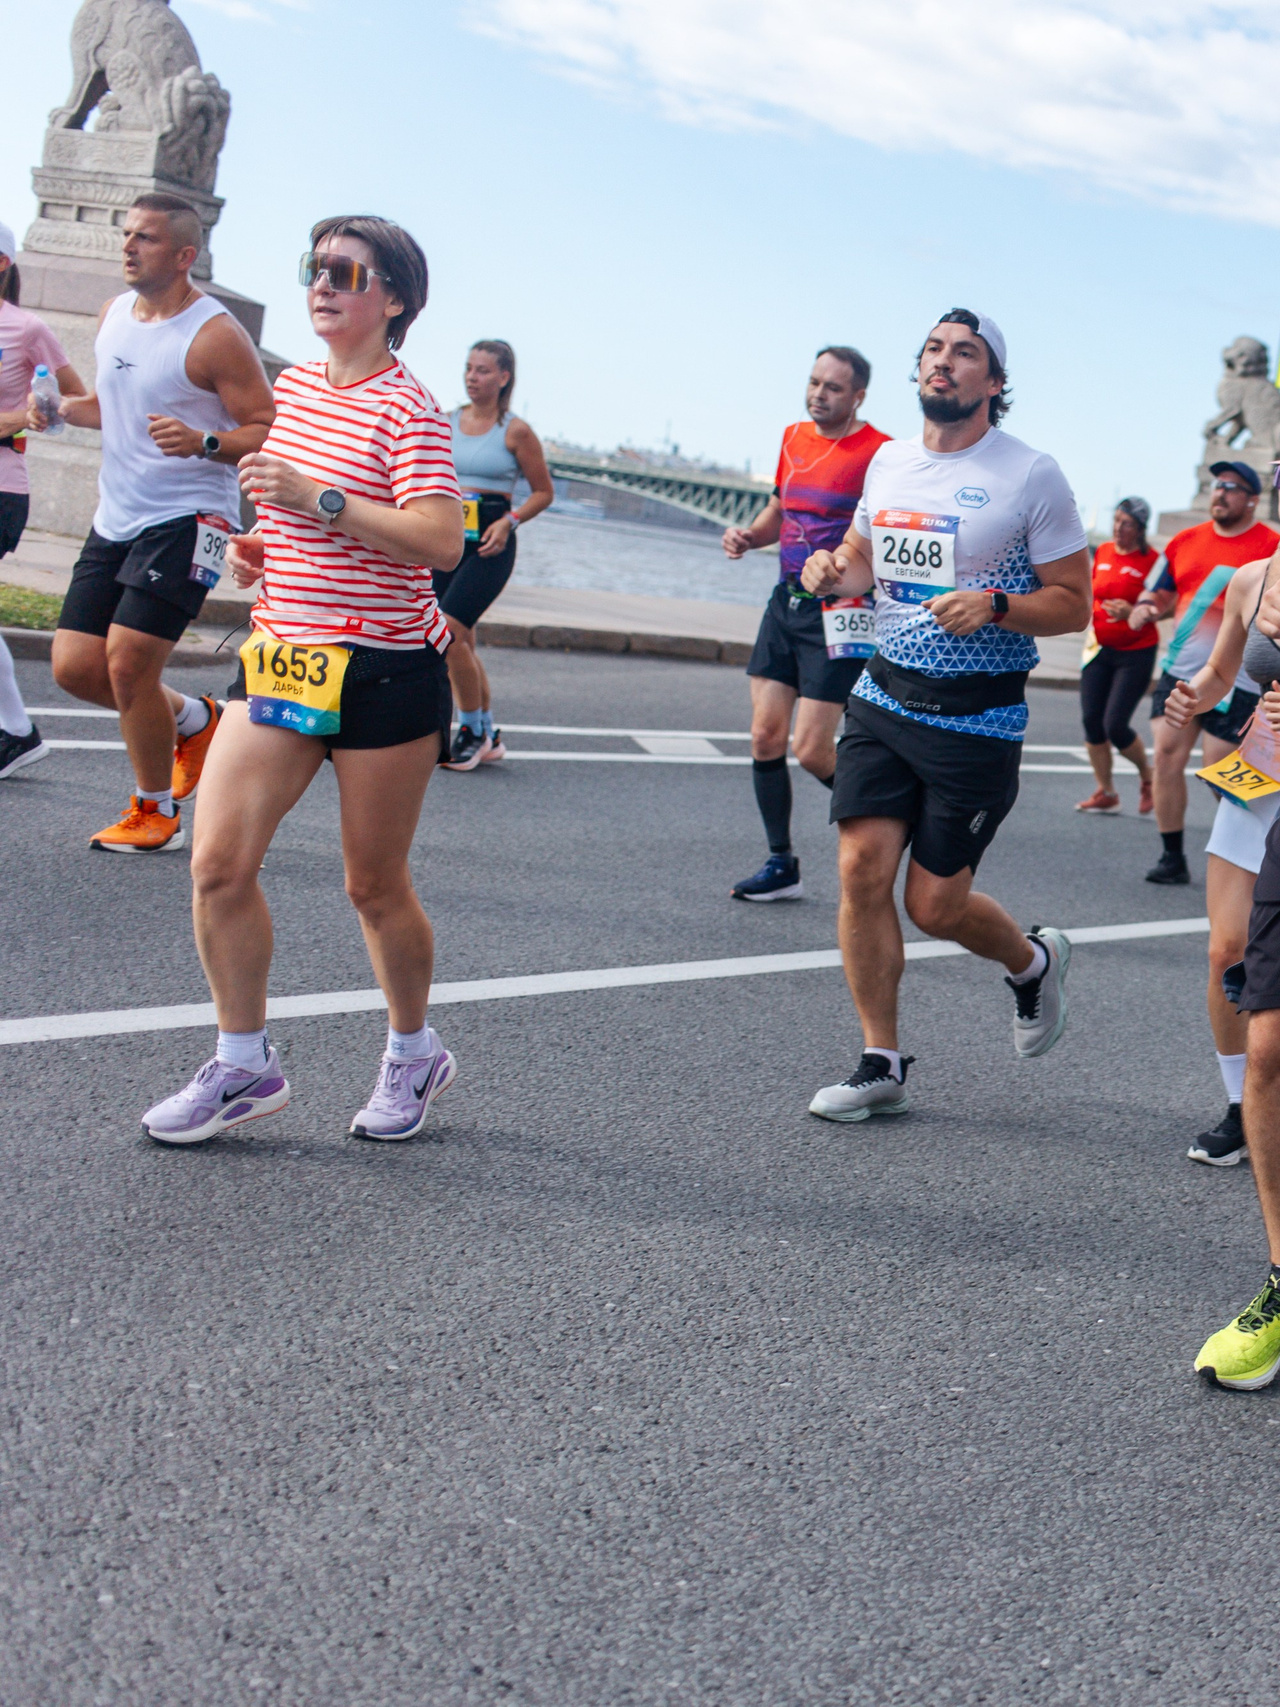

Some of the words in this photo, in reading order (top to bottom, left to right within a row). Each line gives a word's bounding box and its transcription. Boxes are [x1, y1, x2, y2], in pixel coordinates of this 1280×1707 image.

[960, 491, 984, 503] Roche
[883, 535, 943, 569] 2668
[895, 567, 931, 579] ЕВГЕНИЙ
[253, 641, 329, 687] 1653
[272, 681, 304, 696] ДАРЬЯ
